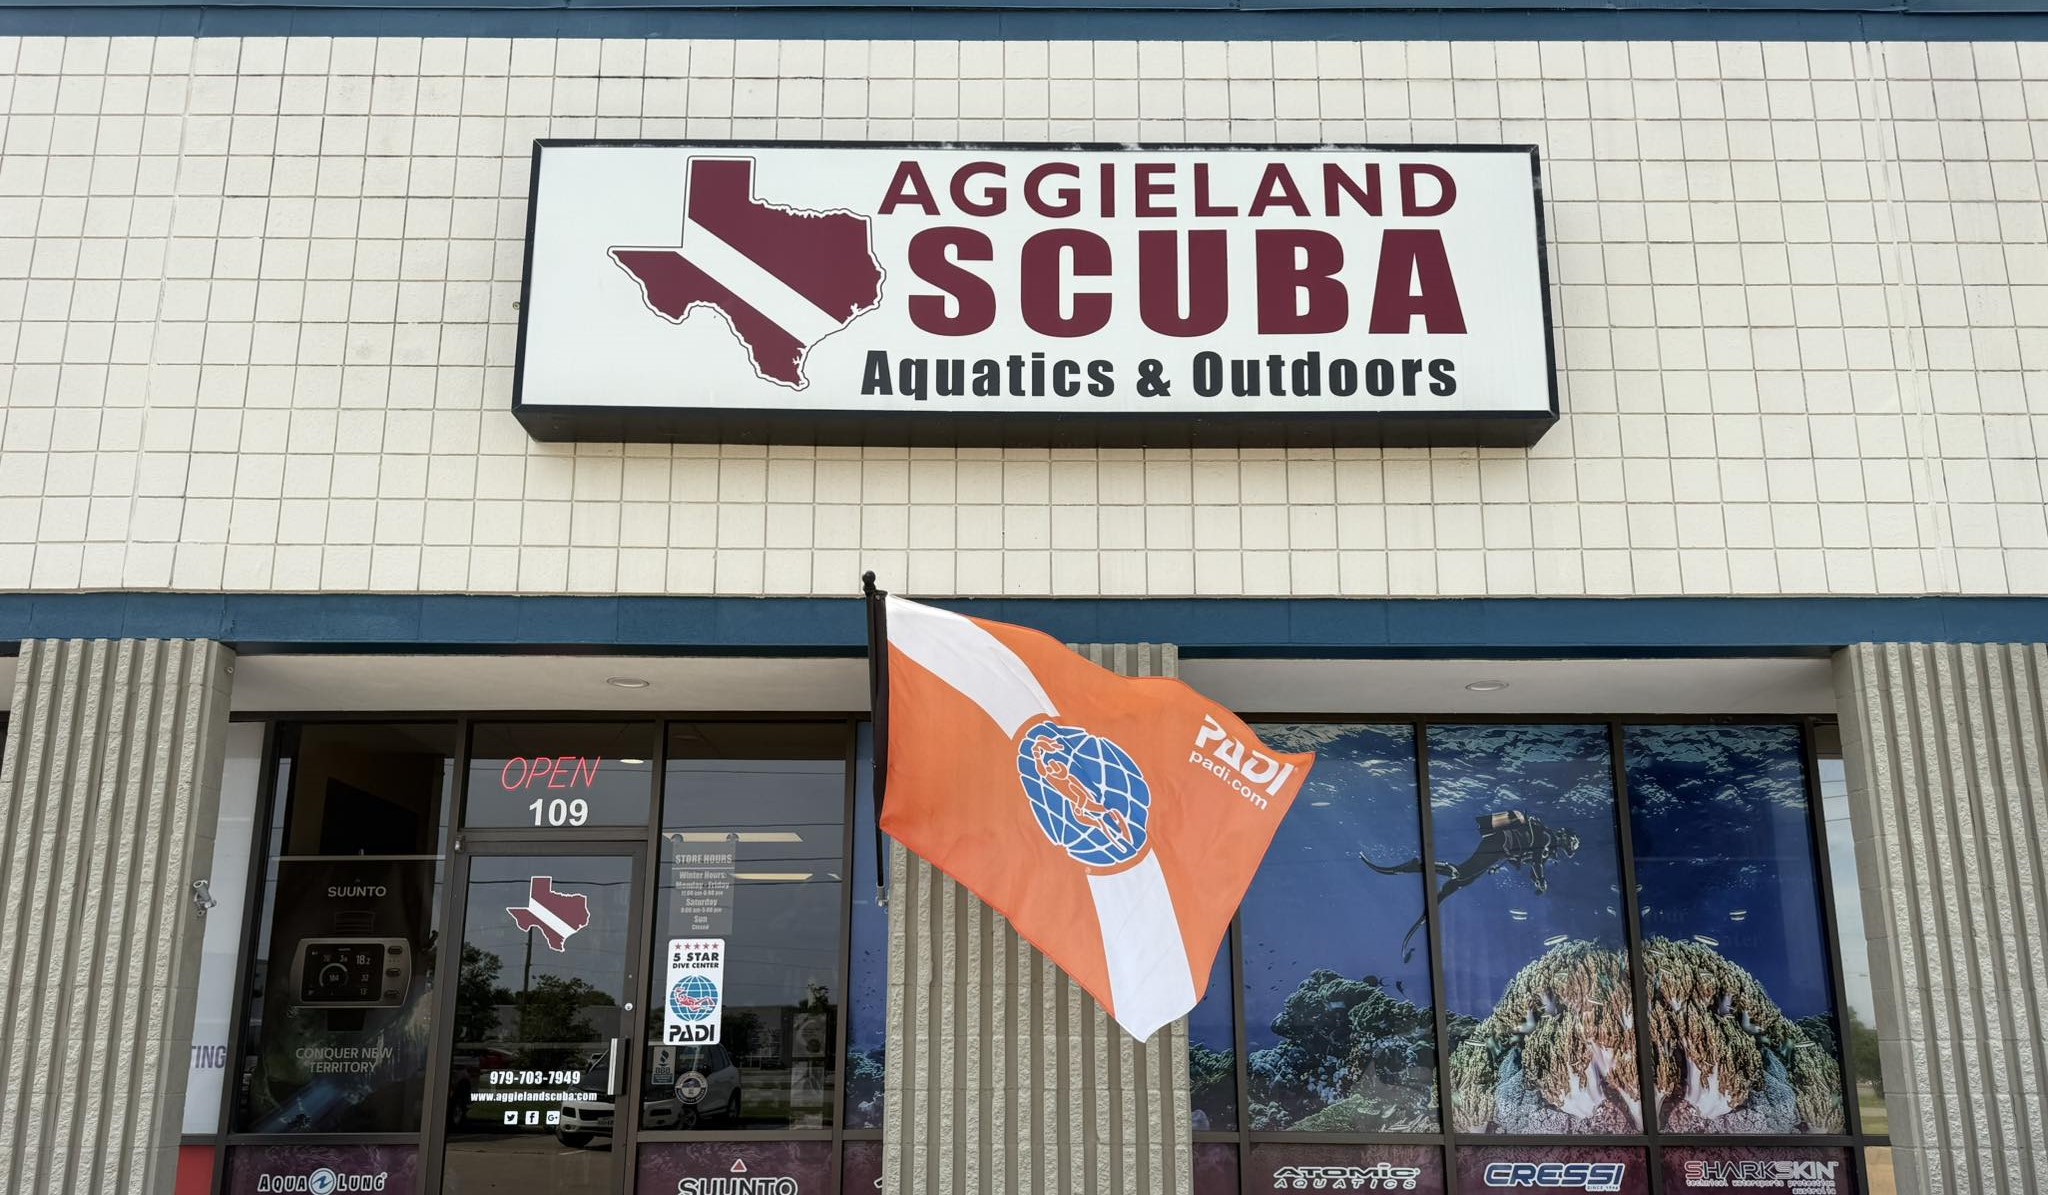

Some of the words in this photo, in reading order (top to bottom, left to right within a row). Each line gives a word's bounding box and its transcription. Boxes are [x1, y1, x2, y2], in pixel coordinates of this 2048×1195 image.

[877, 160, 1457, 219] AGGIELAND
[907, 226, 1468, 338] SCUBA
[861, 350, 1115, 401] Aquatics
[1136, 357, 1171, 397] &
[1193, 351, 1457, 397] Outdoors
[1194, 713, 1295, 797] PADI
[501, 755, 601, 791] OPEN
[1188, 750, 1269, 811] padi.com
[529, 798, 589, 827] 109
[675, 854, 703, 865] STORE
[704, 853, 733, 864] HOURS
[327, 885, 387, 898] SUUNTO
[673, 952, 681, 962] 5
[686, 952, 720, 962] STAR
[669, 1024, 715, 1042] PADI
[295, 1047, 359, 1061] CONQUER
[360, 1047, 394, 1060] NEW
[309, 1061, 378, 1073] TERRITORY
[489, 1071, 581, 1085] 979-703-7949
[470, 1091, 598, 1103] www.aggielandscuba.com
[1484, 1162, 1625, 1187] CRESSI
[1684, 1160, 1836, 1180] SHARKSKIN
[257, 1173, 307, 1192] AQUA
[337, 1173, 386, 1192] LUNG
[678, 1177, 799, 1195] SUUNTO
[1273, 1178, 1417, 1189] AQUATICS
[1686, 1179, 1729, 1187] technical
[1732, 1180, 1785, 1188] watersports
[1787, 1179, 1836, 1188] protection
